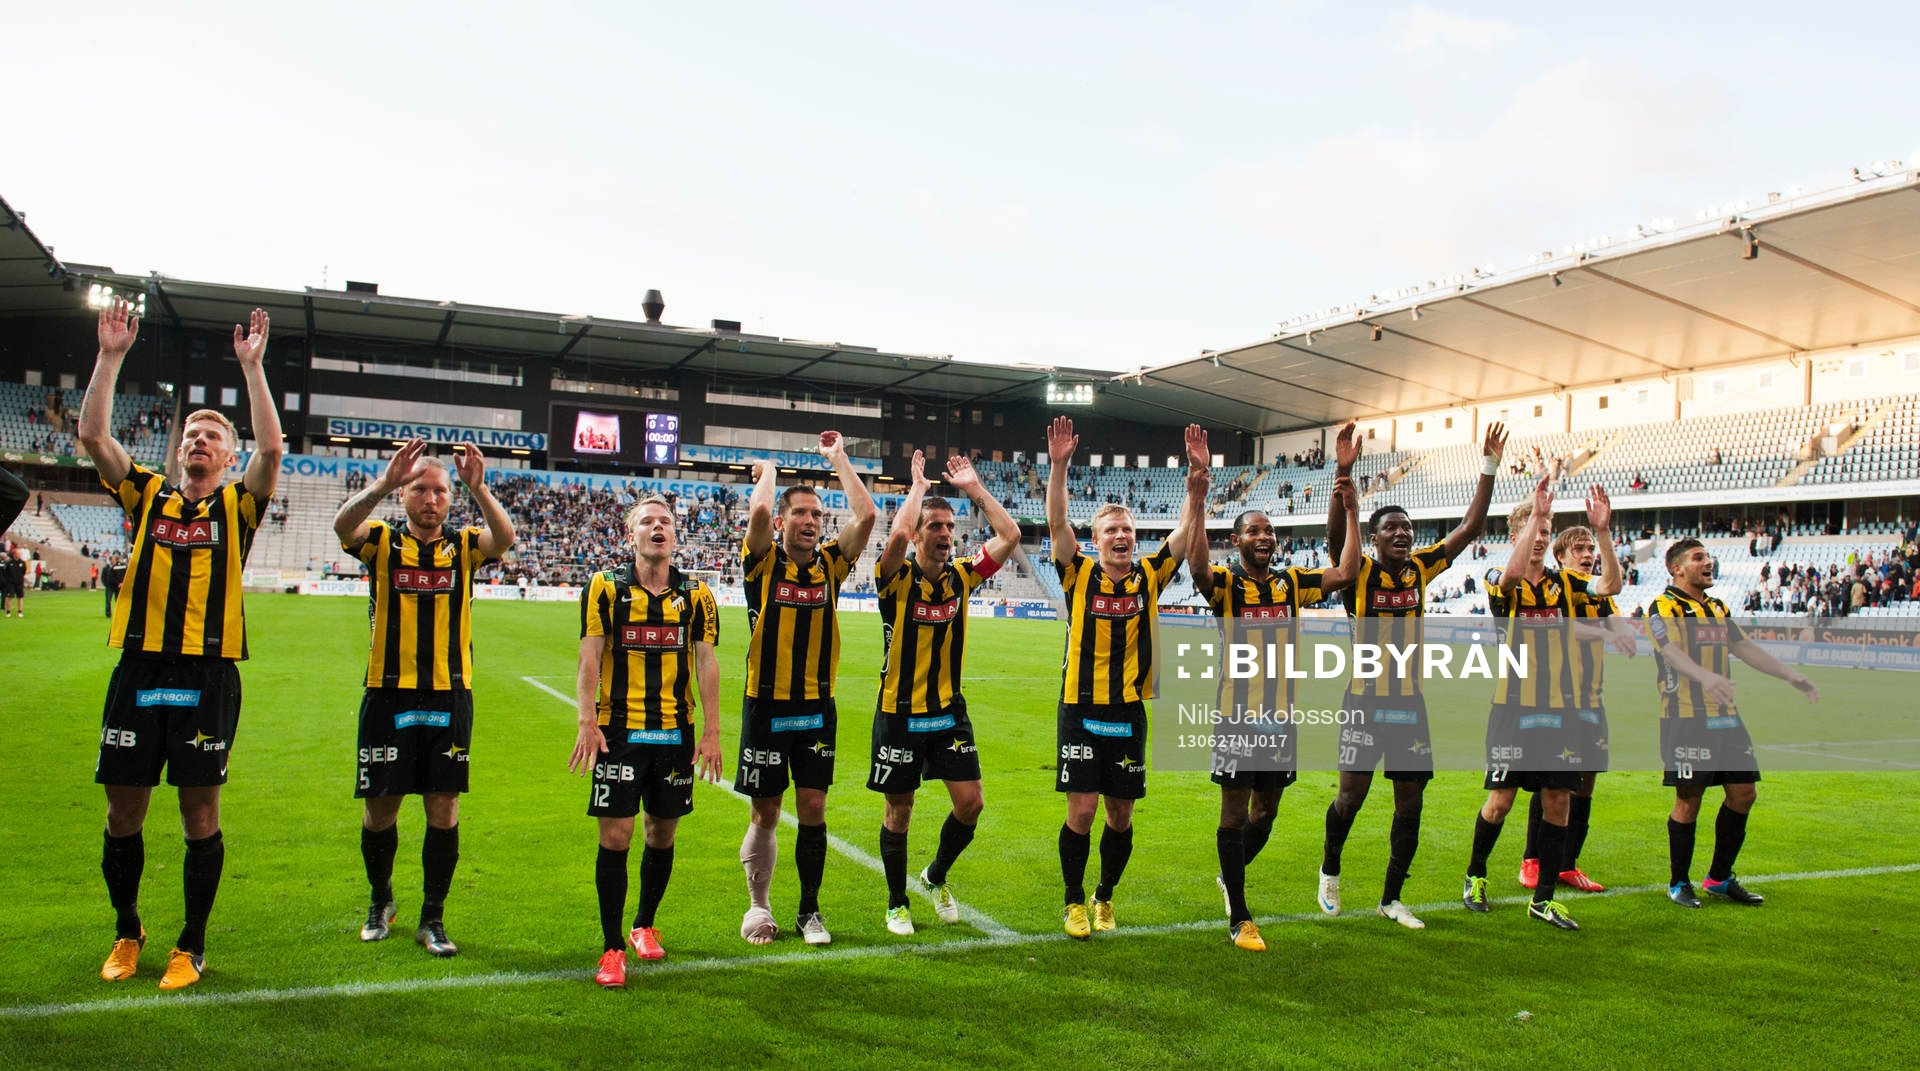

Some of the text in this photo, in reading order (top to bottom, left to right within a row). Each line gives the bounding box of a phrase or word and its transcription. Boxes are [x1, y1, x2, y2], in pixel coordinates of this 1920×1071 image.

[330, 420, 431, 441] SUPRAS
[649, 432, 674, 443] 00:00
[708, 447, 836, 470] MFF SUPPO
[281, 458, 338, 478] SOM
[156, 524, 207, 540] BRA
[398, 573, 449, 585] BRA
[780, 587, 824, 599] BRA
[1377, 594, 1415, 604] BRA
[917, 605, 957, 617] BRA
[1095, 599, 1137, 610] BRA
[1244, 611, 1285, 621] BRA
[1520, 612, 1556, 620] BRA
[626, 631, 676, 640] BRA
[1822, 631, 1910, 647] Swedbank
[1807, 648, 1830, 660] HELA
[140, 691, 196, 703] EHRENBORG
[101, 726, 137, 748] EB
[631, 731, 679, 740] EHRENBORG
[1341, 728, 1374, 746] SEB
[359, 746, 399, 763] SEB
[743, 748, 782, 766] SEB
[877, 745, 914, 763] SEB
[1061, 744, 1094, 760] SEB
[1339, 744, 1358, 765] 20
[1491, 746, 1523, 760] SEB
[1674, 747, 1712, 760] SEB
[594, 763, 635, 781] SEB
[874, 763, 893, 785] 17
[1061, 763, 1070, 783] 6
[1215, 755, 1238, 779] 24
[1491, 763, 1510, 782] 27
[1674, 762, 1694, 780] 10
[359, 767, 371, 790] 5
[741, 765, 760, 789] 14
[594, 783, 610, 808] 12
